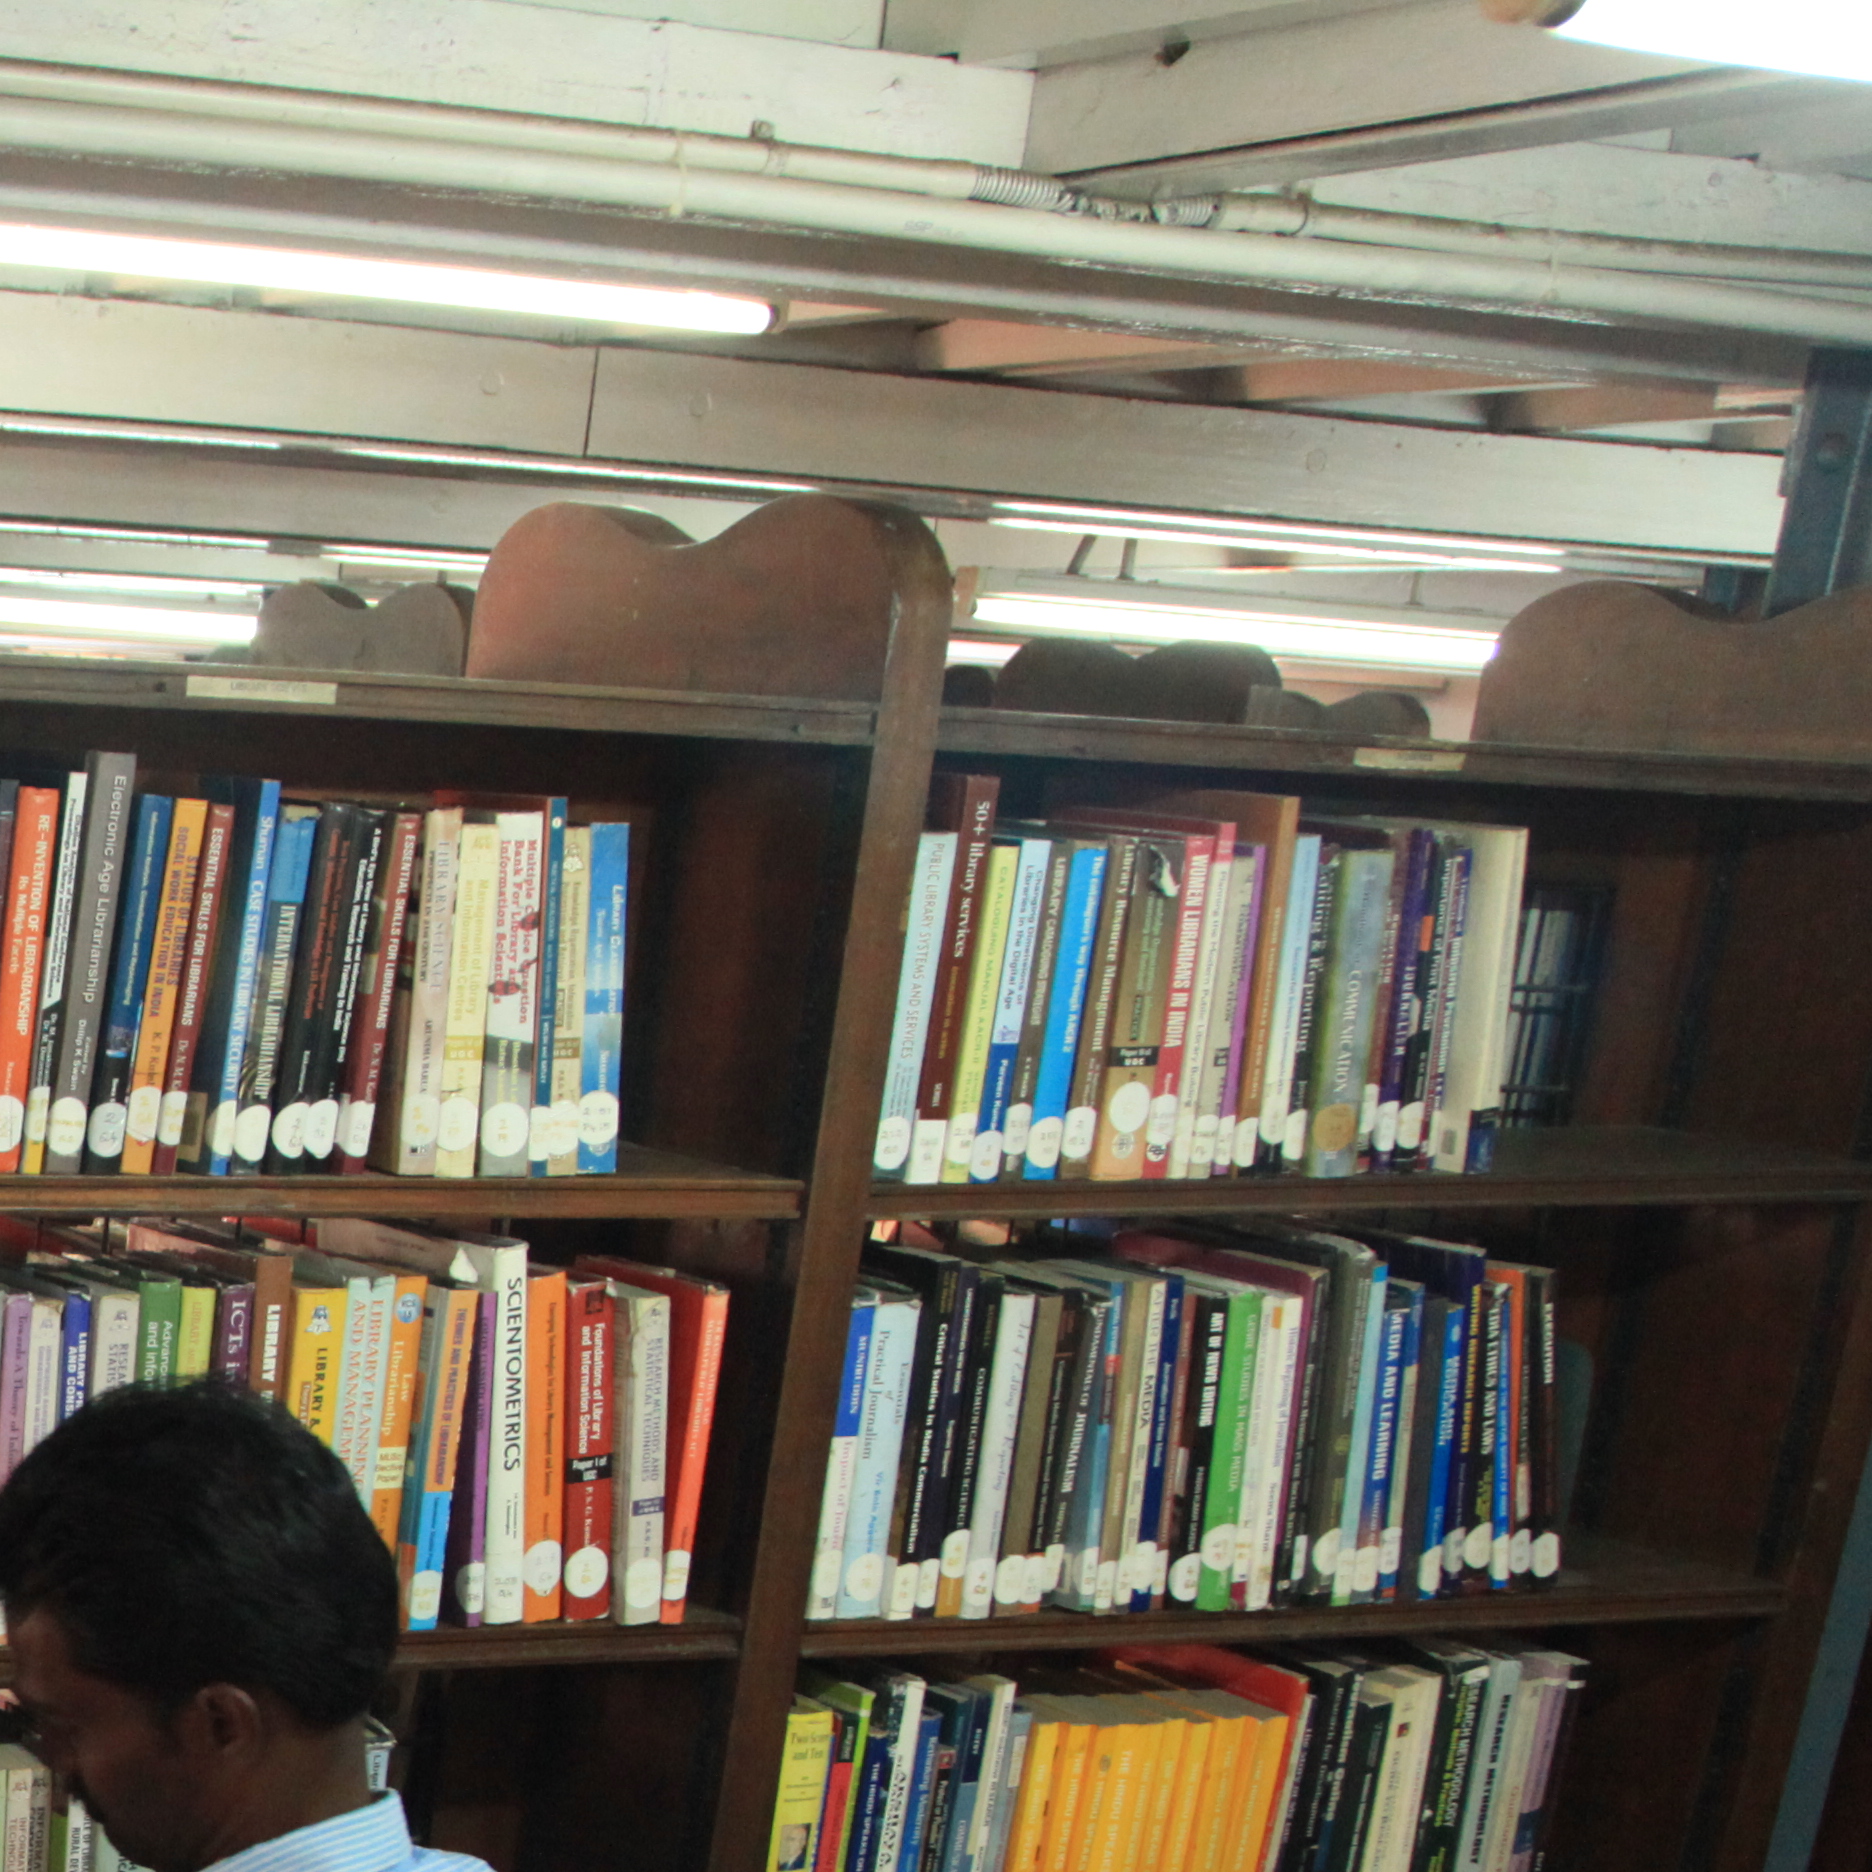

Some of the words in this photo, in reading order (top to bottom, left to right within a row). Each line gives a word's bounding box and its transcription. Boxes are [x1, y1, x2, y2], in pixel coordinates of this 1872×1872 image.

[104, 776, 126, 856] Electronic
[972, 801, 990, 835] 50+
[29, 815, 49, 910] RE-INVENTION
[204, 828, 224, 888] ESSENTIAL
[255, 816, 273, 869] Shuman
[928, 843, 944, 880] PUBLIC
[97, 861, 116, 892] Age
[960, 843, 984, 893] library
[1185, 855, 1208, 906] WOMEN
[197, 892, 214, 930] SKILLS
[249, 880, 265, 910] CASE
[921, 885, 938, 928] LIBRARY
[27, 915, 39, 932] OF
[193, 934, 207, 955] FOR
[242, 914, 260, 963] STUDIES
[954, 898, 975, 957] services
[83, 899, 111, 1002] Librarianship
[240, 967, 253, 979] IN
[268, 906, 296, 1000] INTERNATIONAL
[913, 932, 931, 979] SYSTEMS
[1173, 910, 1200, 989] LIBRARIANS
[16, 937, 37, 1035] LIBRARIANSHIP
[182, 959, 203, 1025] LIBRARIANS
[233, 983, 251, 1034] LIBRARY
[909, 983, 923, 1006] AND
[1170, 993, 1188, 1007] IN
[255, 1006, 282, 1099] LIBRARIANSHIP
[901, 1010, 920, 1058] SERVICES
[1164, 1011, 1185, 1047] INDIA
[1333, 970, 1362, 1093] COMMUNICATION
[225, 1038, 243, 1092] SECURITY
[582, 1326, 591, 1345] and
[933, 1324, 948, 1365] Critical
[1208, 1336, 1221, 1347] OF
[1210, 1313, 1224, 1332] ART
[1543, 1304, 1552, 1383] EXECUTION
[504, 1277, 522, 1471] SCIENTOMETRICS
[593, 1323, 604, 1386] Foundations
[873, 1330, 890, 1385] Practical
[1204, 1352, 1219, 1382] NEWS
[382, 1341, 404, 1436] Librarianship
[401, 1373, 412, 1403] Law
[580, 1351, 591, 1412] Information
[593, 1390, 603, 1399] of
[927, 1369, 942, 1410] Studies
[589, 1403, 602, 1439] Library
[863, 1389, 882, 1459] Journalism
[925, 1414, 936, 1425] in
[1199, 1387, 1215, 1426] EDITING
[579, 1415, 589, 1454] Science
[920, 1429, 934, 1463] Media
[907, 1467, 928, 1554] Commercialism
[1489, 1695, 1510, 1763] RESEARCH
[1470, 1768, 1497, 1864] METHODOLOGY
